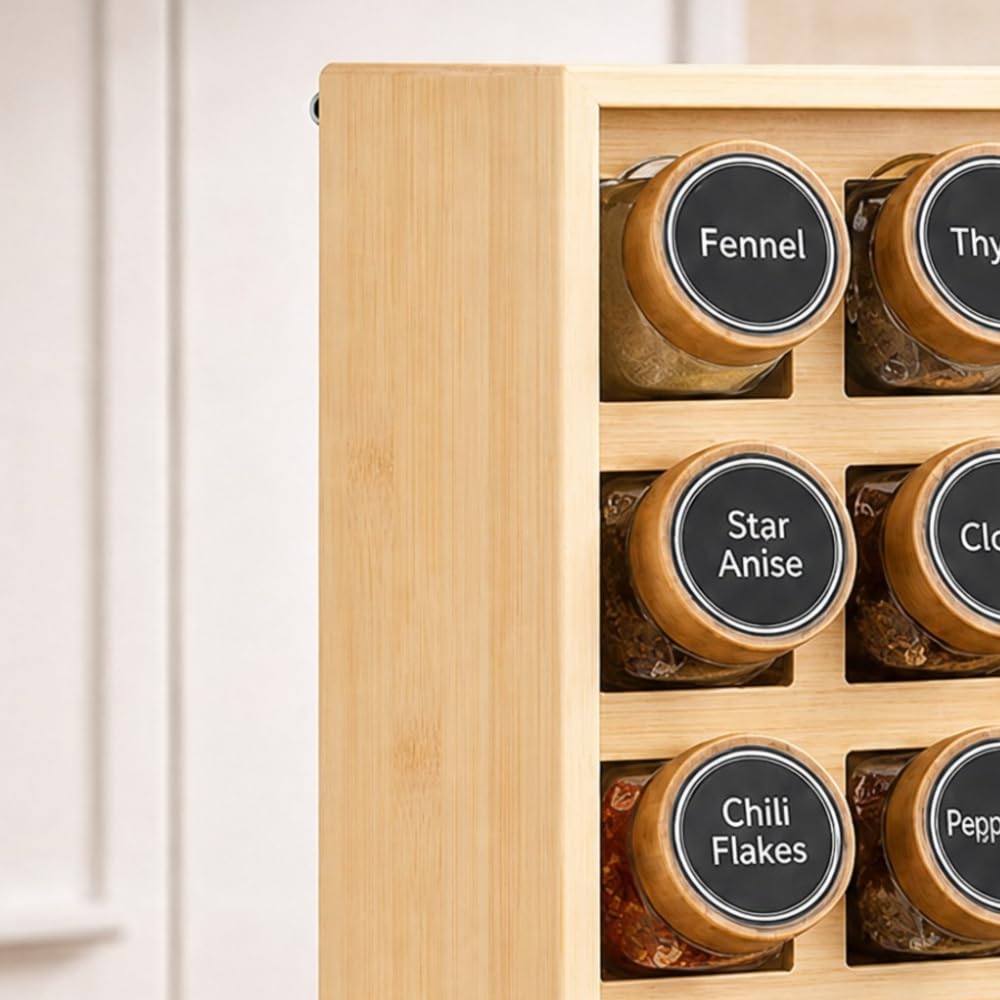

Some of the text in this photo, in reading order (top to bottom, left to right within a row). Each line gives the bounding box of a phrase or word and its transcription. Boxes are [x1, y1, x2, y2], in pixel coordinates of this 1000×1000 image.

[701, 228, 806, 259] Fennel
[728, 510, 789, 538] Star
[719, 548, 802, 577] Anise
[723, 797, 789, 827] Chili
[712, 836, 807, 865] Flakes
